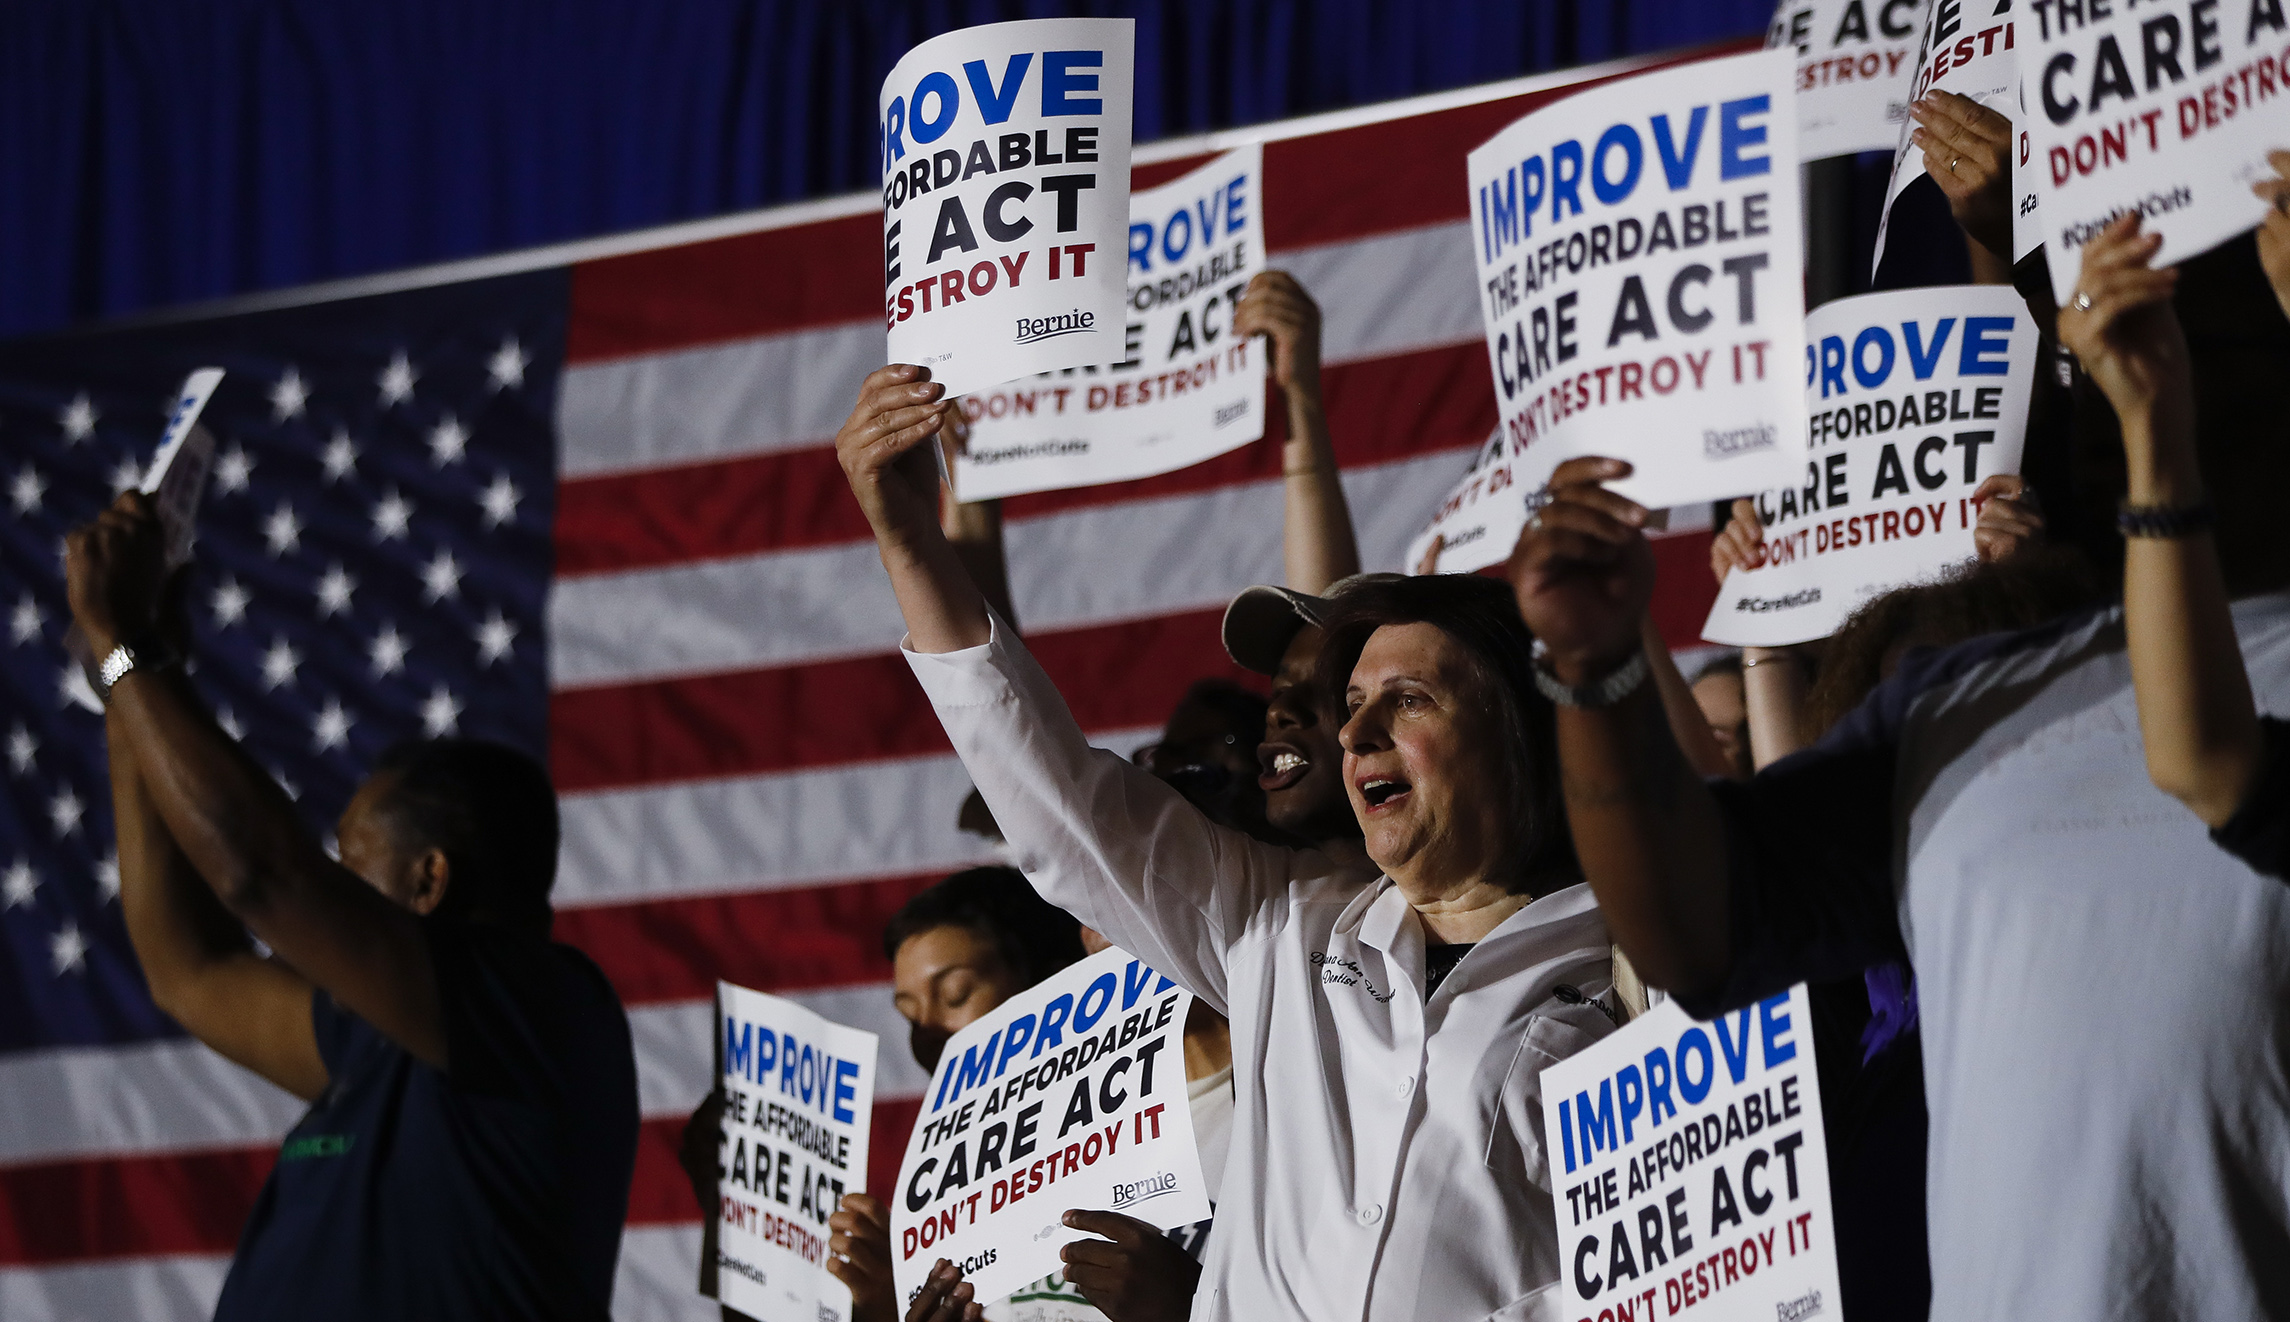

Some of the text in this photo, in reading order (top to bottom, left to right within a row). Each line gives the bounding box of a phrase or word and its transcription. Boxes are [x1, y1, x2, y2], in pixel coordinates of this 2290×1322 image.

[880, 50, 1104, 174] ROVE
[2041, 0, 2222, 126] CARE
[883, 127, 1099, 224] FORDABLE
[1480, 93, 1772, 265] IMPROVE
[2049, 109, 2163, 189] DON'T
[926, 174, 1096, 265] ACT
[1487, 192, 1771, 322] THE AFFORDABLE
[886, 251, 1030, 334] ESTROY
[1048, 243, 1096, 282] IT
[1014, 307, 1096, 341] Bernie
[1498, 252, 1770, 401] CARE ACT
[965, 342, 1248, 424] DON'T DESTROY IT
[1509, 395, 1548, 457] DON'T
[1549, 346, 1714, 426] DESTROY
[1731, 341, 1773, 385] IT
[1809, 387, 2003, 448] FFORDABLE
[1872, 430, 1995, 499] ACT
[1816, 501, 1947, 555] DESTROY
[906, 1034, 1166, 1213] CARE ACT
[920, 993, 1179, 1153] THE AFFORDABLE
[1558, 990, 1798, 1175] IMPROVE
[753, 1097, 850, 1171] AFFORDABLE
[903, 1102, 1165, 1262] DON'T DESTROY IT
[1565, 1074, 1802, 1227] THE AFFORDABLE
[799, 1161, 845, 1226] ACT
[1111, 1170, 1177, 1205] Bernie
[1573, 1130, 1804, 1301] CARE ACT
[764, 1211, 827, 1269] DESTROY
[1665, 1226, 1775, 1317] DESTROY
[1787, 1211, 1812, 1257] IT
